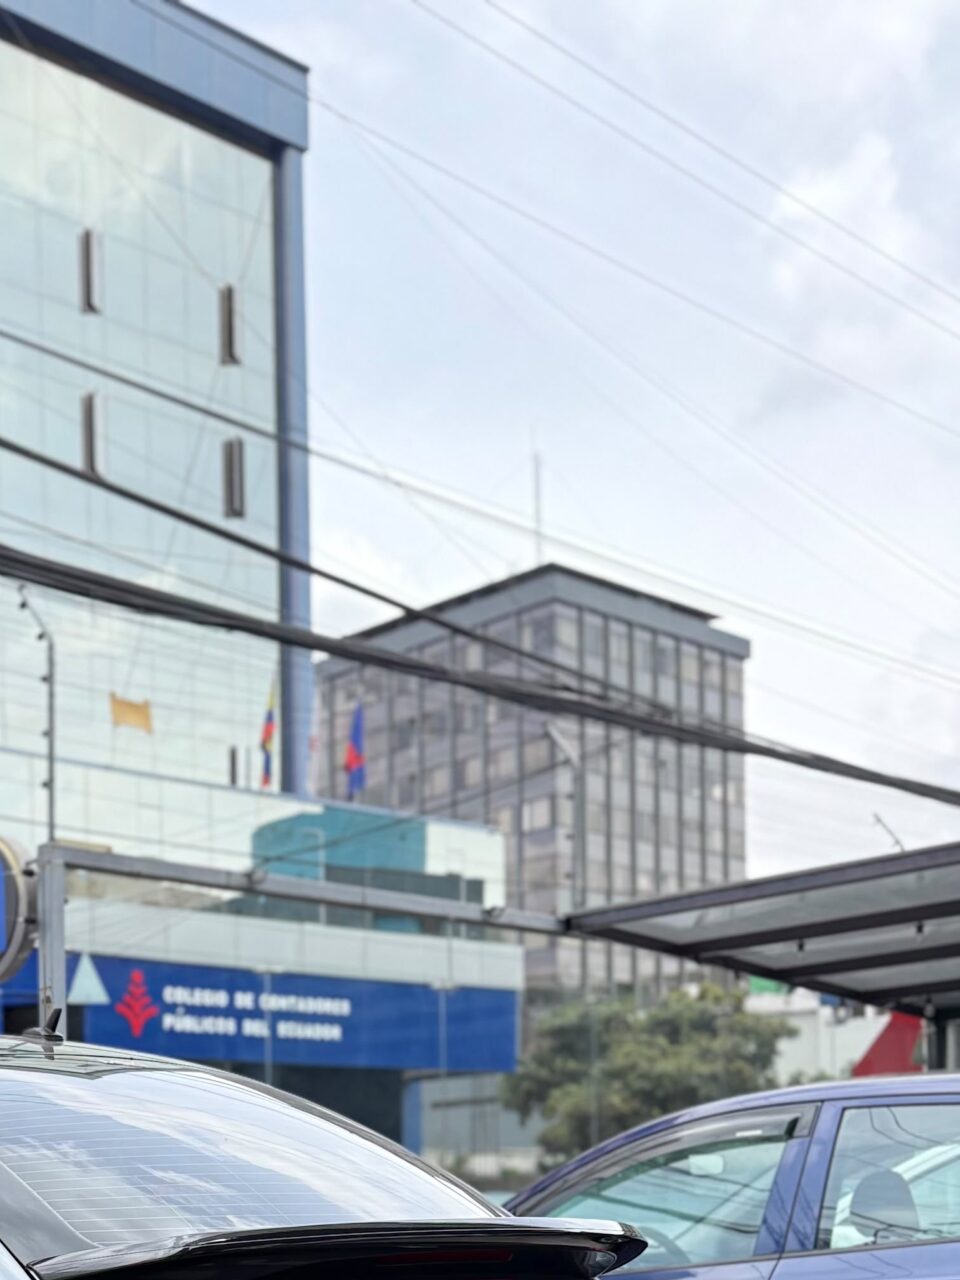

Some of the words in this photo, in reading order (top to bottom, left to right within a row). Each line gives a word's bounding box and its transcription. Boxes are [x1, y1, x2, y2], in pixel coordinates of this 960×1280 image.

[163, 986, 230, 1008] COLEGIO
[234, 990, 256, 1011] DE
[258, 993, 352, 1017] CONTADORES
[242, 1017, 271, 1039] DEL
